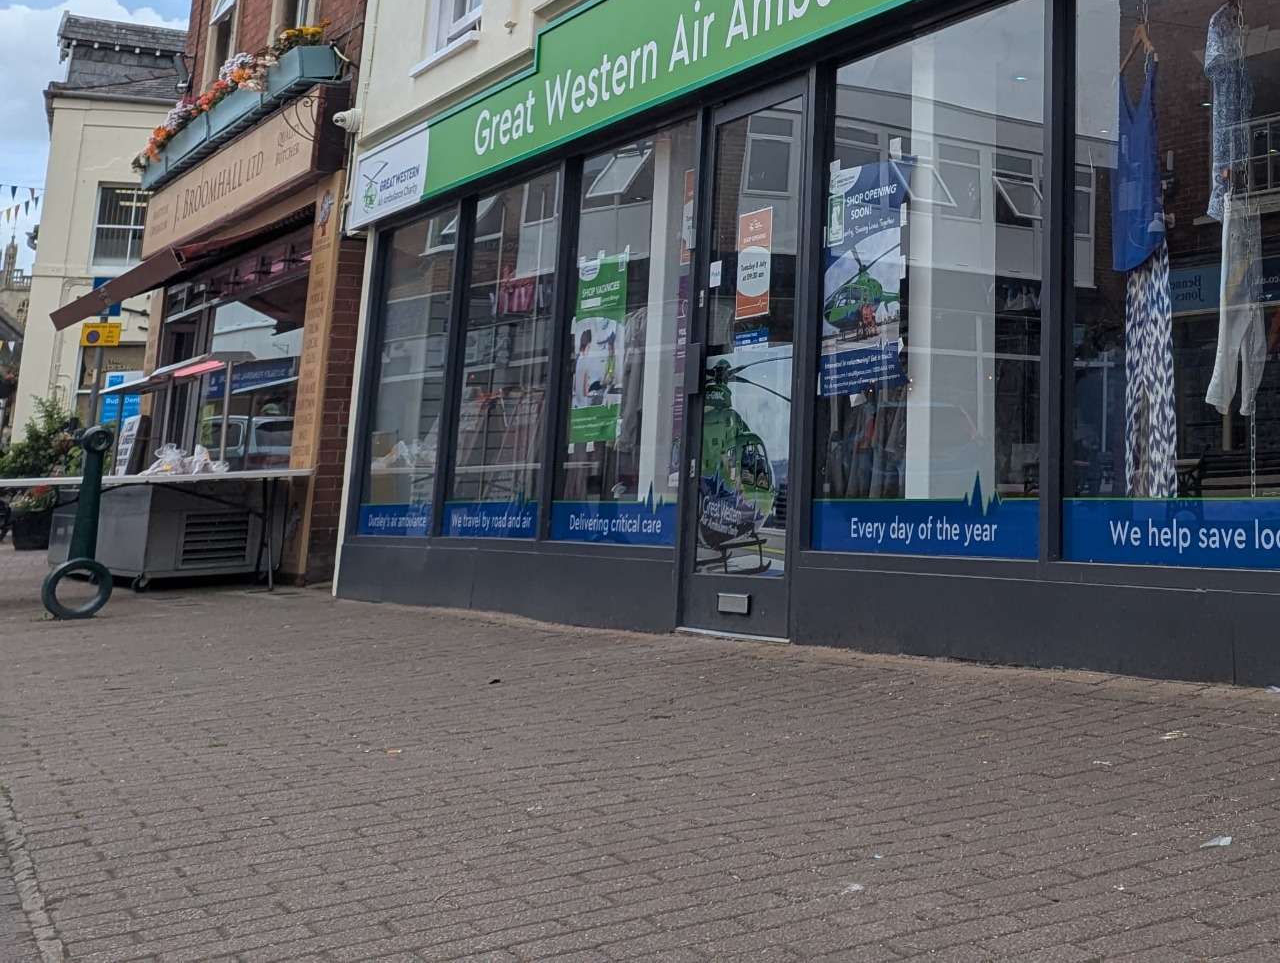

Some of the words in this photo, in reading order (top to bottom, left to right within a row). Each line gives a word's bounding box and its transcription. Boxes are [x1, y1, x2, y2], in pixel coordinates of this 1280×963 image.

[474, 89, 536, 156] Great
[545, 39, 658, 126] Western
[668, 0, 716, 72] Air
[183, 159, 243, 219] BROOMHALL
[246, 151, 264, 182] LTD
[380, 175, 396, 192] GREAT
[395, 164, 420, 184] WESTERN
[846, 194, 864, 206] SHOP
[864, 183, 898, 201] OPENING
[850, 205, 872, 220] SOON!
[368, 514, 390, 530] Dursley's
[390, 513, 398, 527] air
[398, 513, 427, 528] ambulance
[451, 514, 462, 527] We
[463, 513, 481, 527] travel
[481, 511, 490, 531] by
[492, 512, 507, 528] road
[507, 511, 521, 528] and
[521, 512, 532, 528] air
[702, 495, 720, 518] Great
[720, 499, 742, 524] Western
[569, 513, 609, 535] Delivering
[611, 513, 640, 533] critical
[641, 519, 662, 534] care
[850, 517, 886, 544] Every
[889, 516, 914, 544] day
[918, 516, 933, 540] of
[936, 516, 960, 540] the
[964, 522, 998, 547] year
[1109, 520, 1141, 547] We
[1148, 518, 1191, 554] help
[1198, 527, 1246, 549] save
